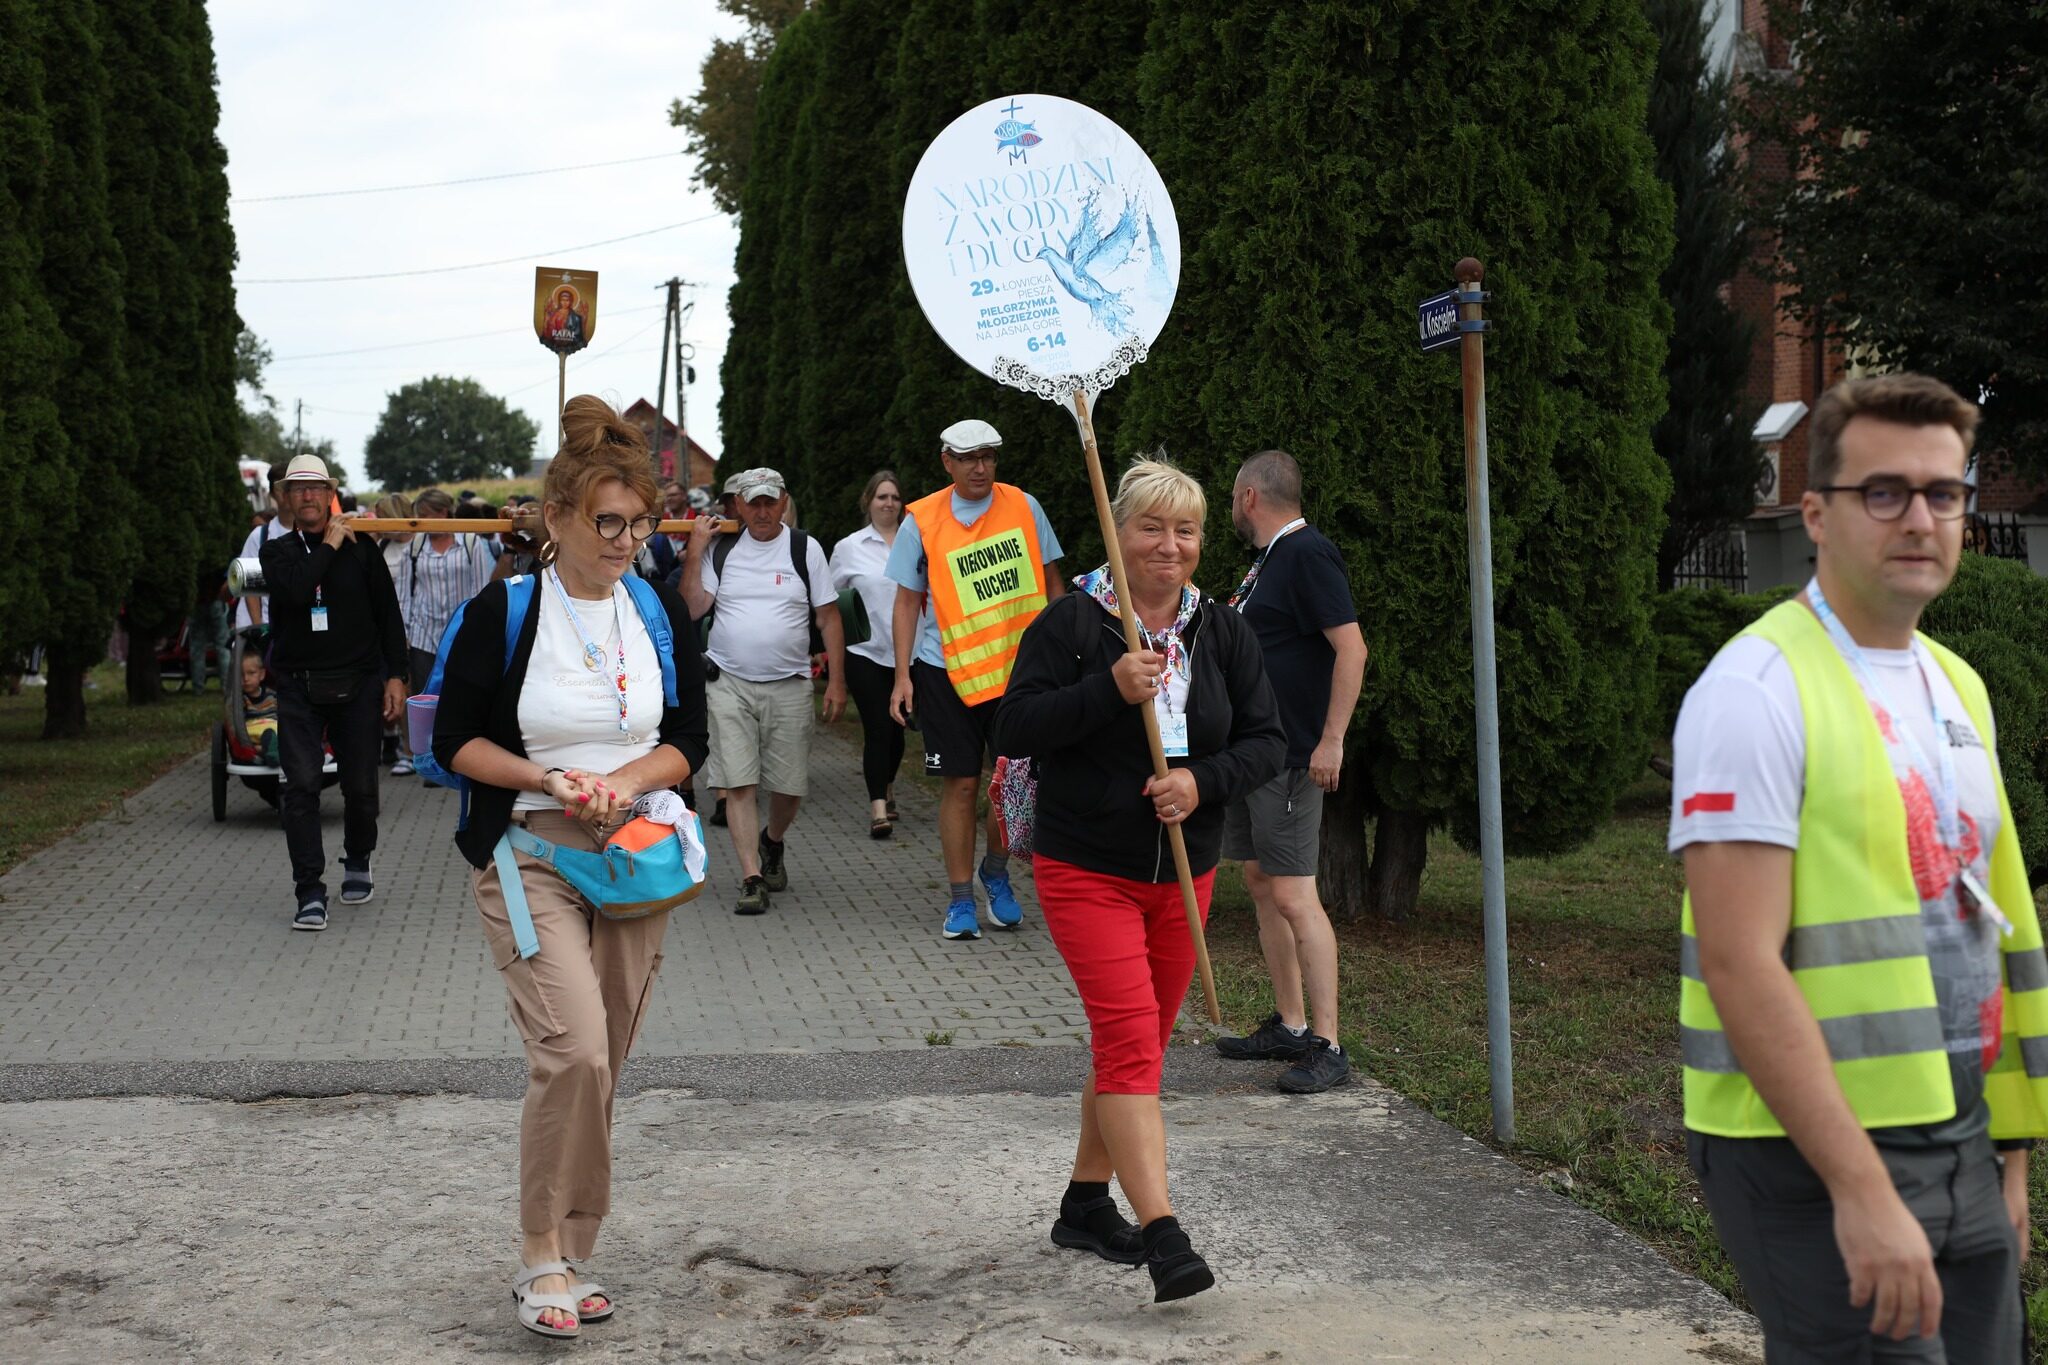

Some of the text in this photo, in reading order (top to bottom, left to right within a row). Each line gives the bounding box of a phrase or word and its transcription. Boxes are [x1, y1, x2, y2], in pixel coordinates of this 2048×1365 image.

[972, 197, 1074, 237] WODY
[969, 278, 1000, 297] 29.
[1017, 284, 1055, 300] PIESZA
[980, 295, 1057, 318] PIELGRZYMKA
[976, 306, 1060, 330] MŁODZIEŻOWA
[975, 330, 993, 342] NA
[1026, 331, 1067, 352] 6-14
[972, 567, 1020, 602] RUCHEM
